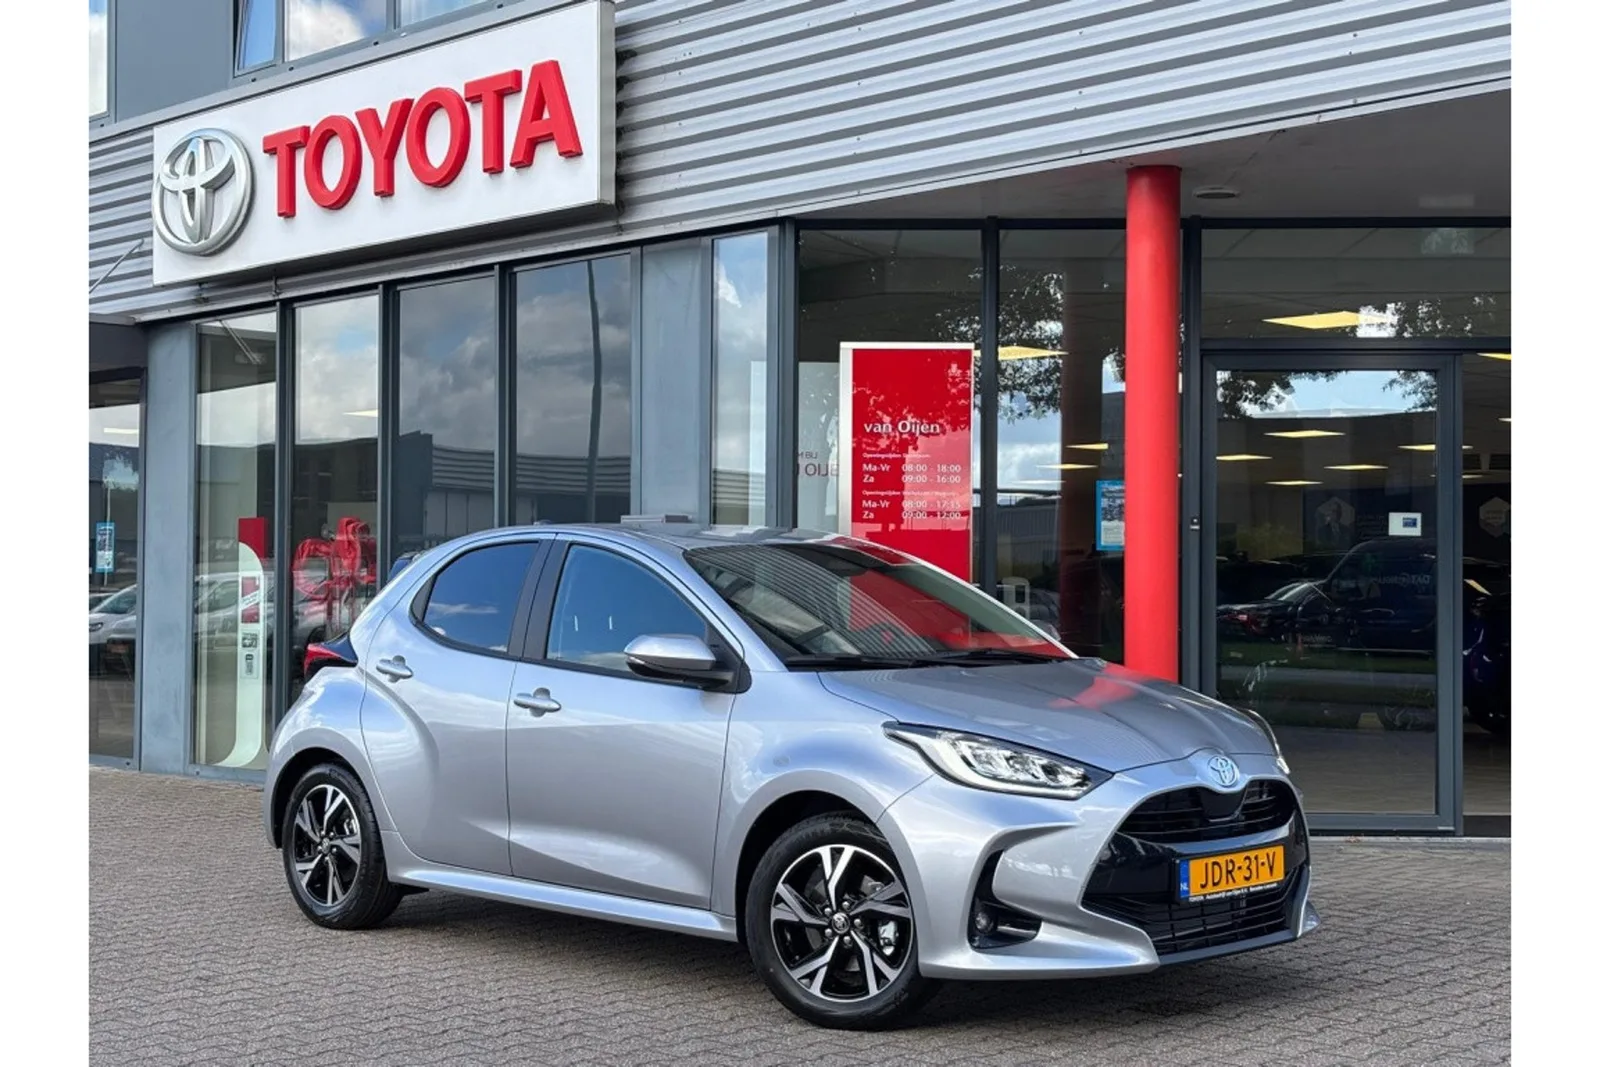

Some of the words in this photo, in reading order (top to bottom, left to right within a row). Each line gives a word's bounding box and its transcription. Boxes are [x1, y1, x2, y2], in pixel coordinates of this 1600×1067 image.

[263, 59, 583, 218] TOYOTA
[864, 423, 892, 433] van
[898, 420, 940, 436] Oijen
[862, 463, 891, 472] Ma-Vr
[901, 463, 928, 472] 08:00
[936, 464, 962, 473] 18:00
[862, 474, 875, 483] Za
[901, 474, 928, 483] 09:00
[936, 475, 961, 483] 16:00
[862, 500, 890, 508] Ma-Vr
[901, 500, 928, 508] 08:00
[862, 511, 875, 519] Za
[901, 511, 928, 519] 09:00
[936, 511, 961, 519] 12:00
[1200, 851, 1276, 889] JDR-31-V
[1180, 882, 1189, 891] NL
